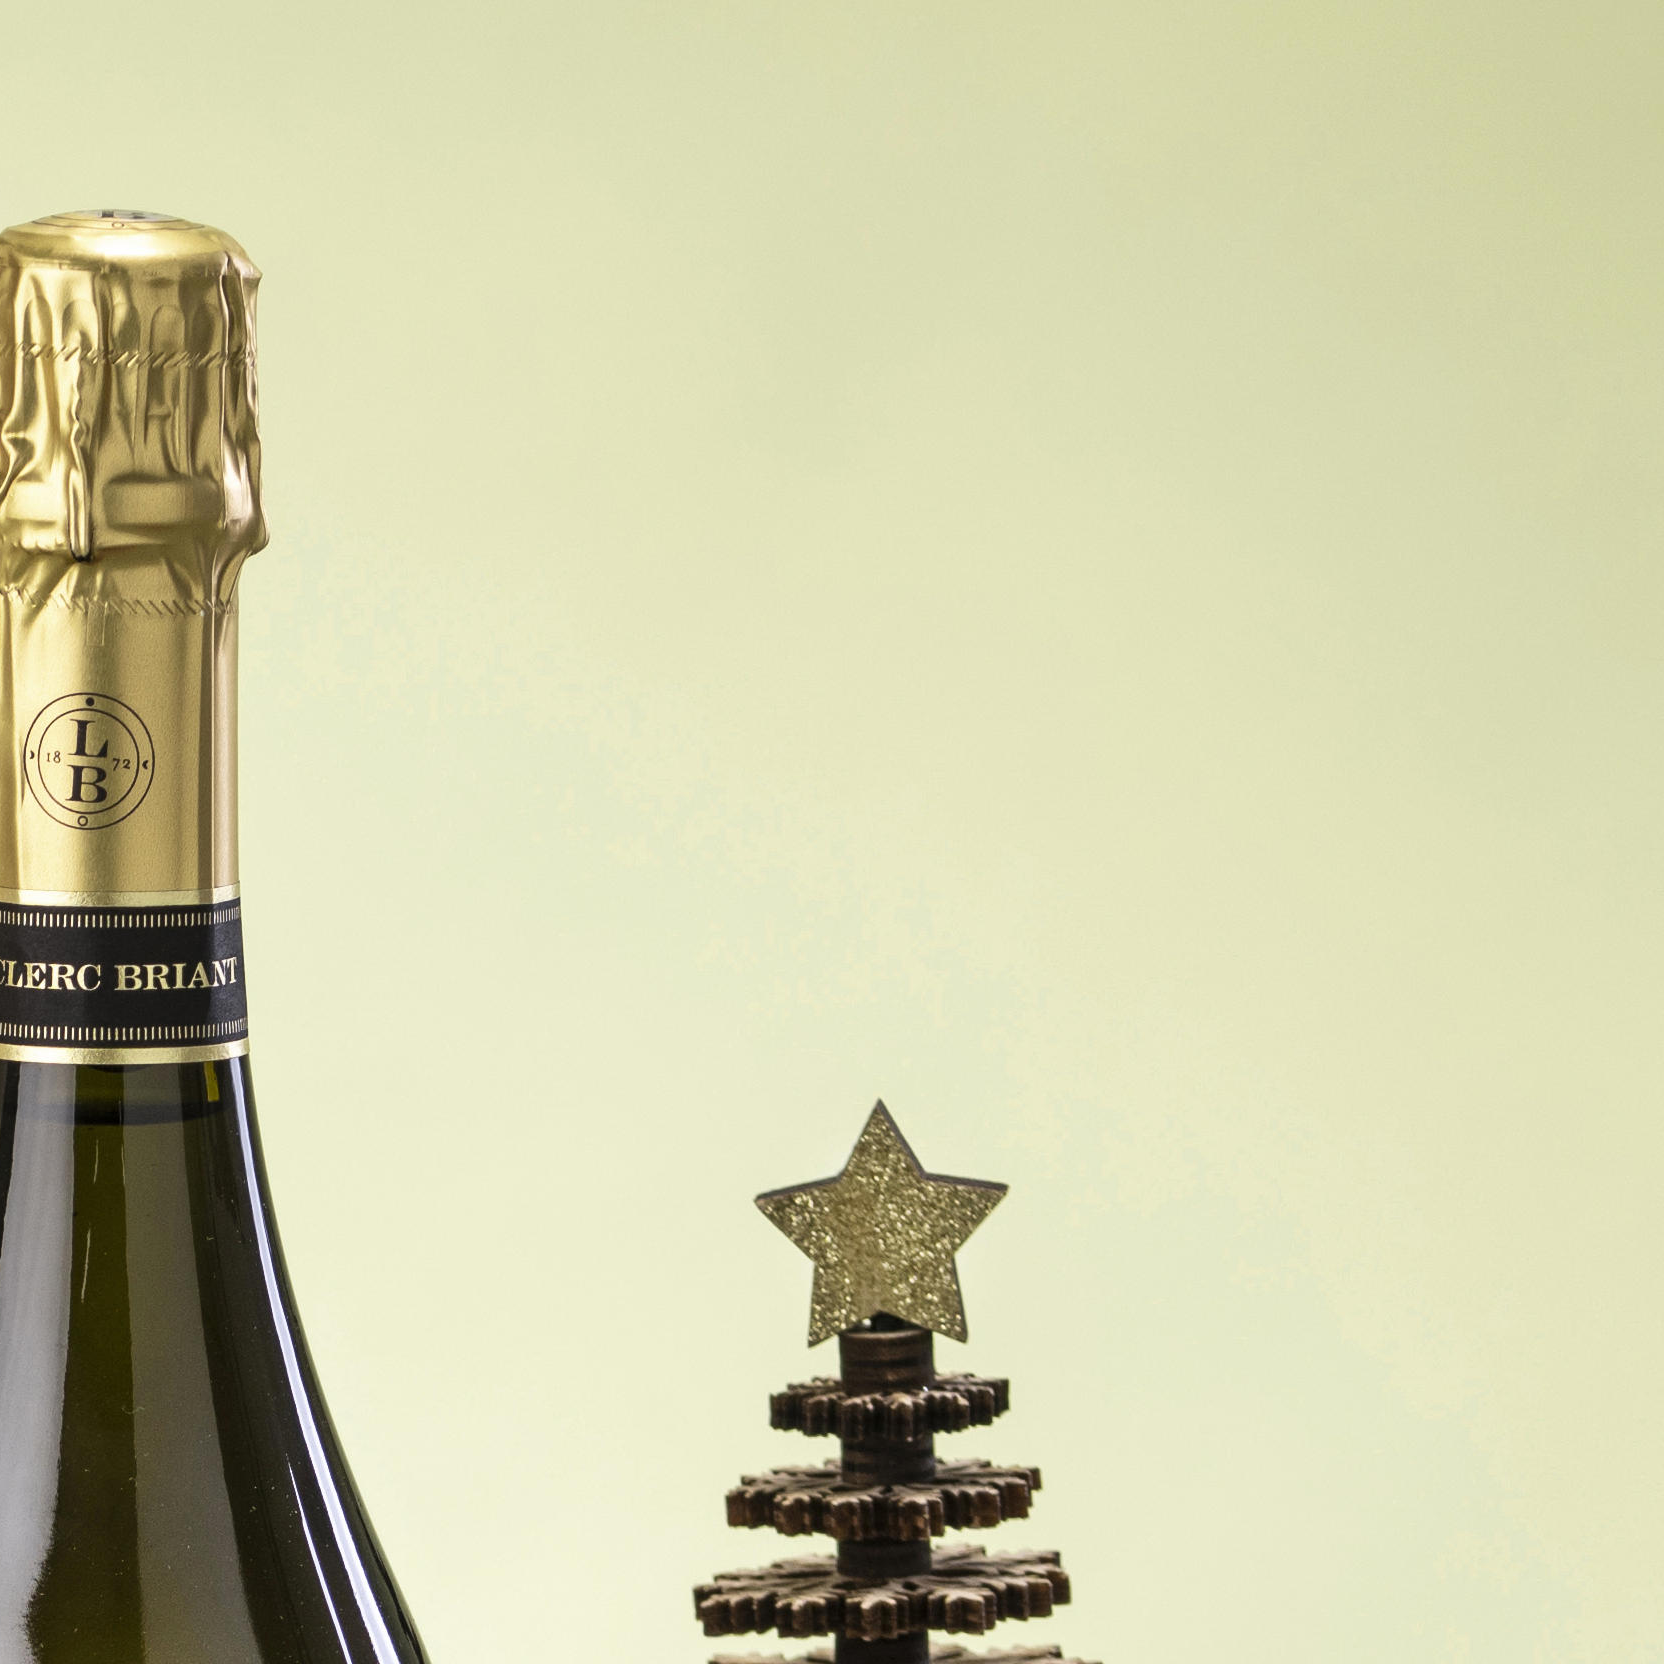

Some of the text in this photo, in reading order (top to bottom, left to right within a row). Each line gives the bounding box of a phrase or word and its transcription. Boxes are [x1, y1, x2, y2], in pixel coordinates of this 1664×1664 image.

[69, 719, 109, 758] L
[112, 758, 130, 771] 72
[65, 764, 108, 804] B
[115, 957, 237, 990] BRIANT
